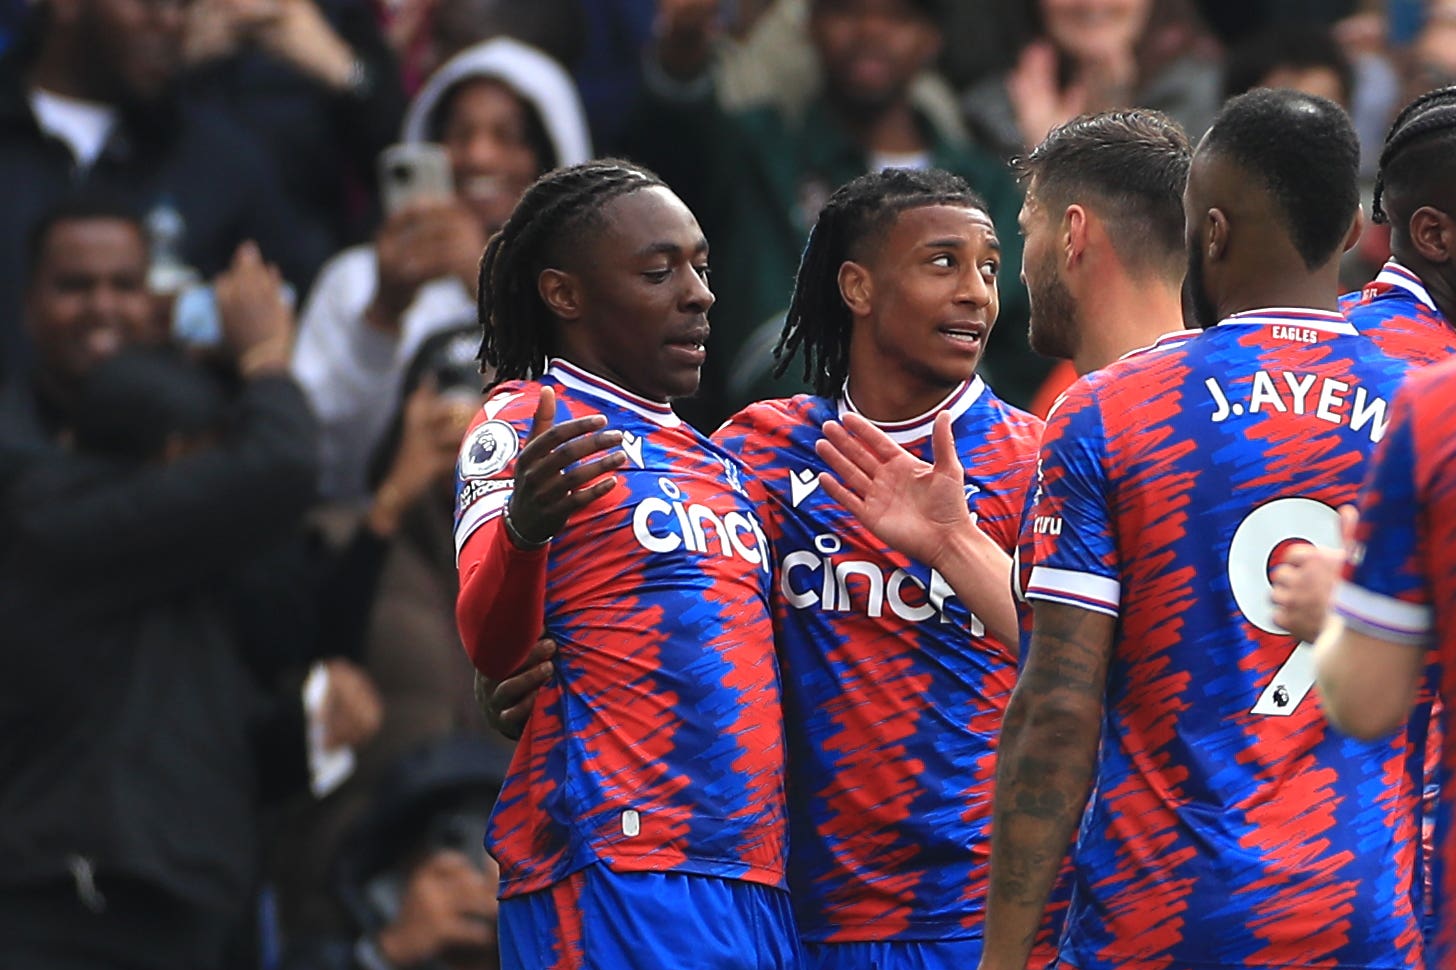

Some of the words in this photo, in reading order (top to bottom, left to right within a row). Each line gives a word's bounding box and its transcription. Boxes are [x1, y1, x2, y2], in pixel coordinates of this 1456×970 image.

[1272, 325, 1318, 344] EAGLES
[1205, 370, 1390, 443] J.AYEW
[1228, 498, 1342, 716] 9
